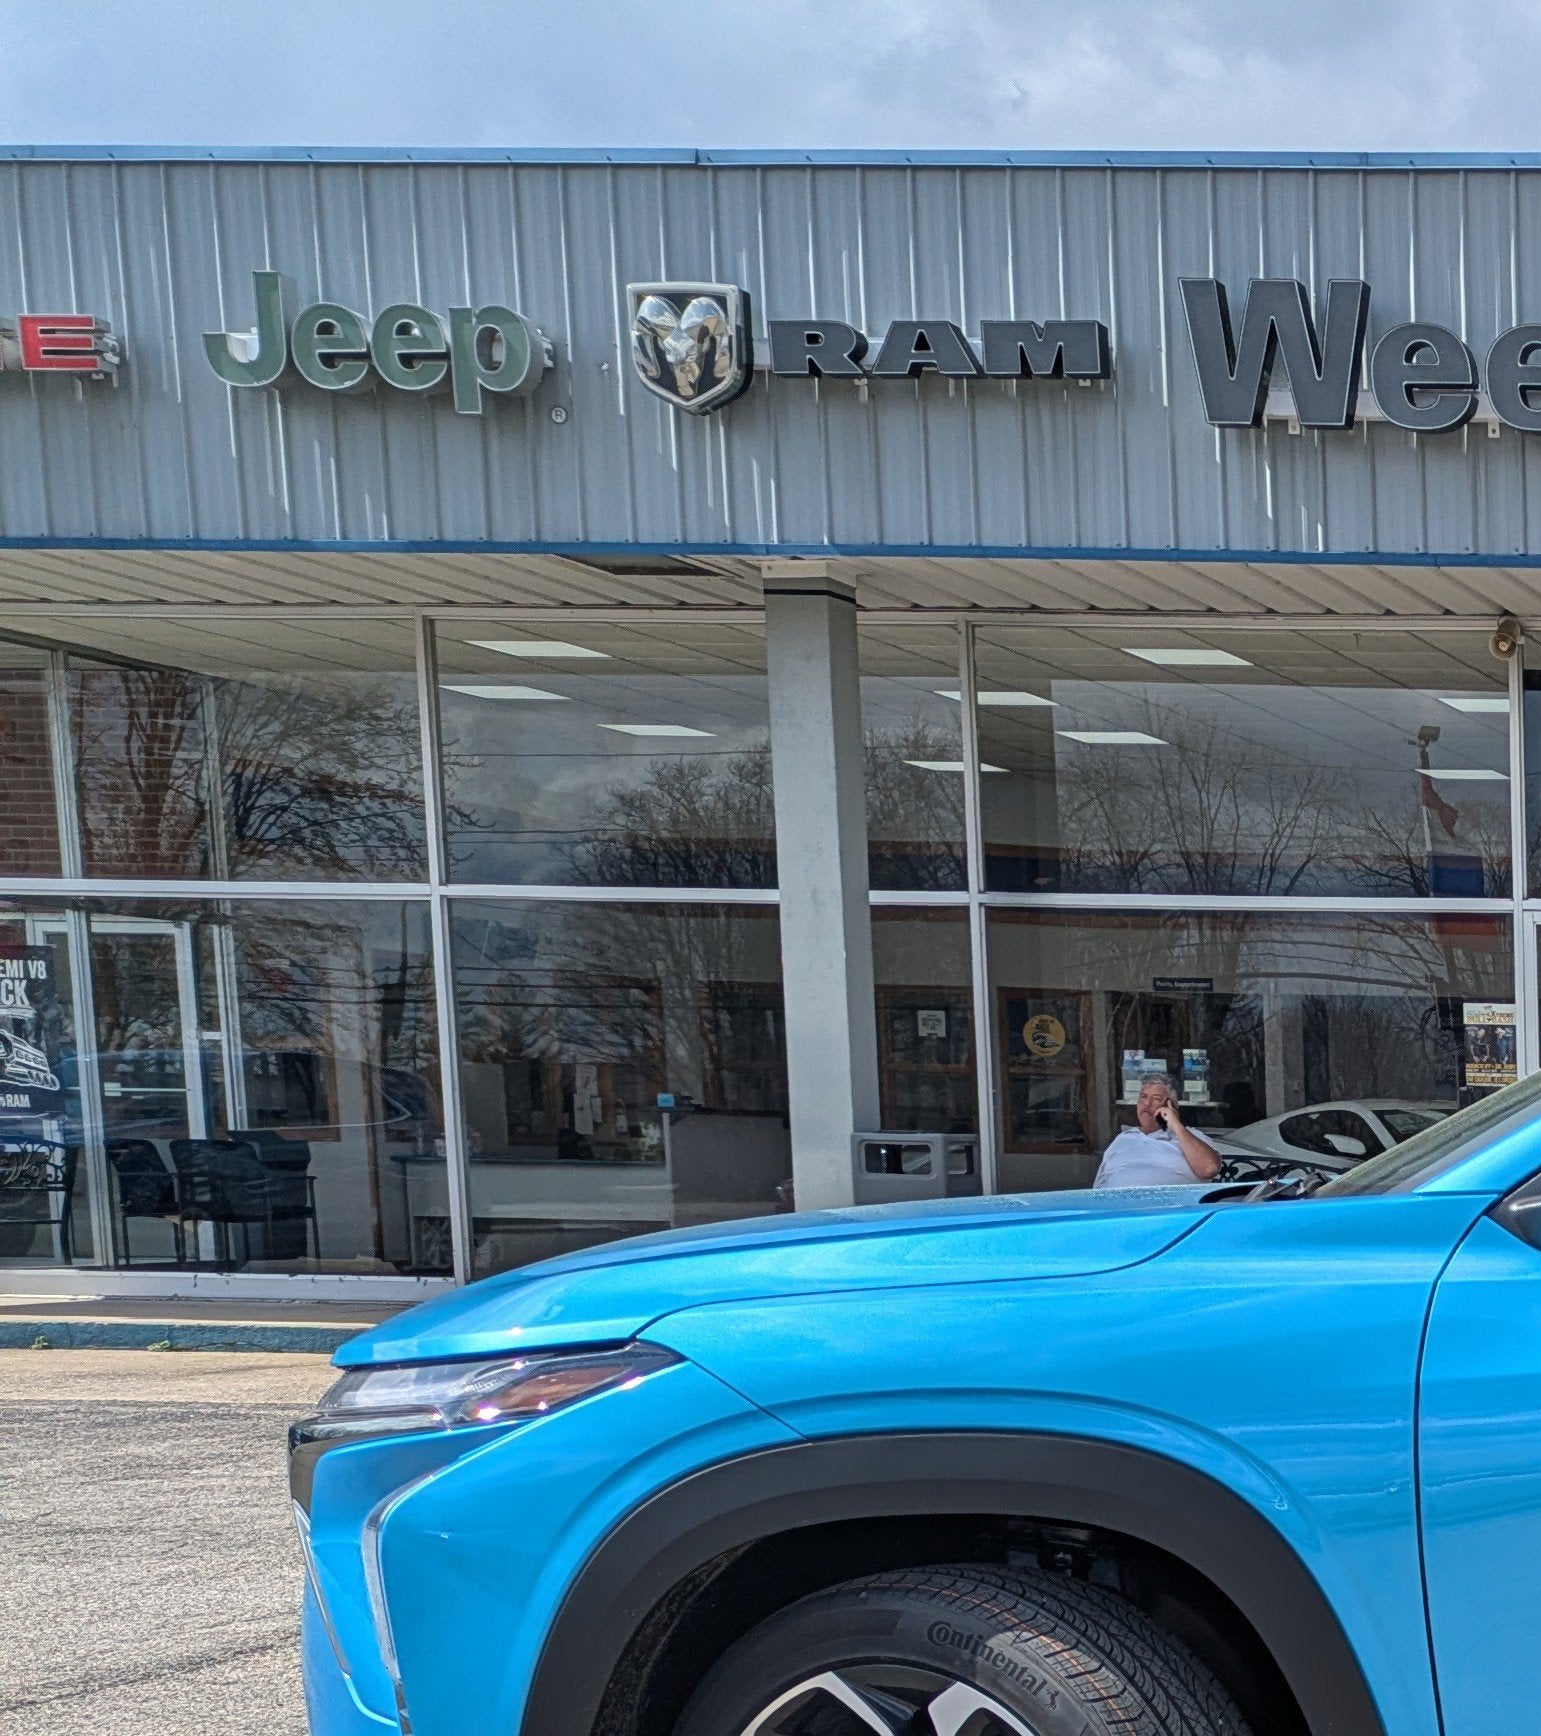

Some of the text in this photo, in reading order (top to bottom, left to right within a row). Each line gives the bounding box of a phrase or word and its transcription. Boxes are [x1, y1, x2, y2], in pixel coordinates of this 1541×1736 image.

[201, 269, 532, 415] Jeep
[767, 319, 1110, 380] RAM
[27, 960, 47, 980] V8
[926, 1620, 1048, 1697] Continental
